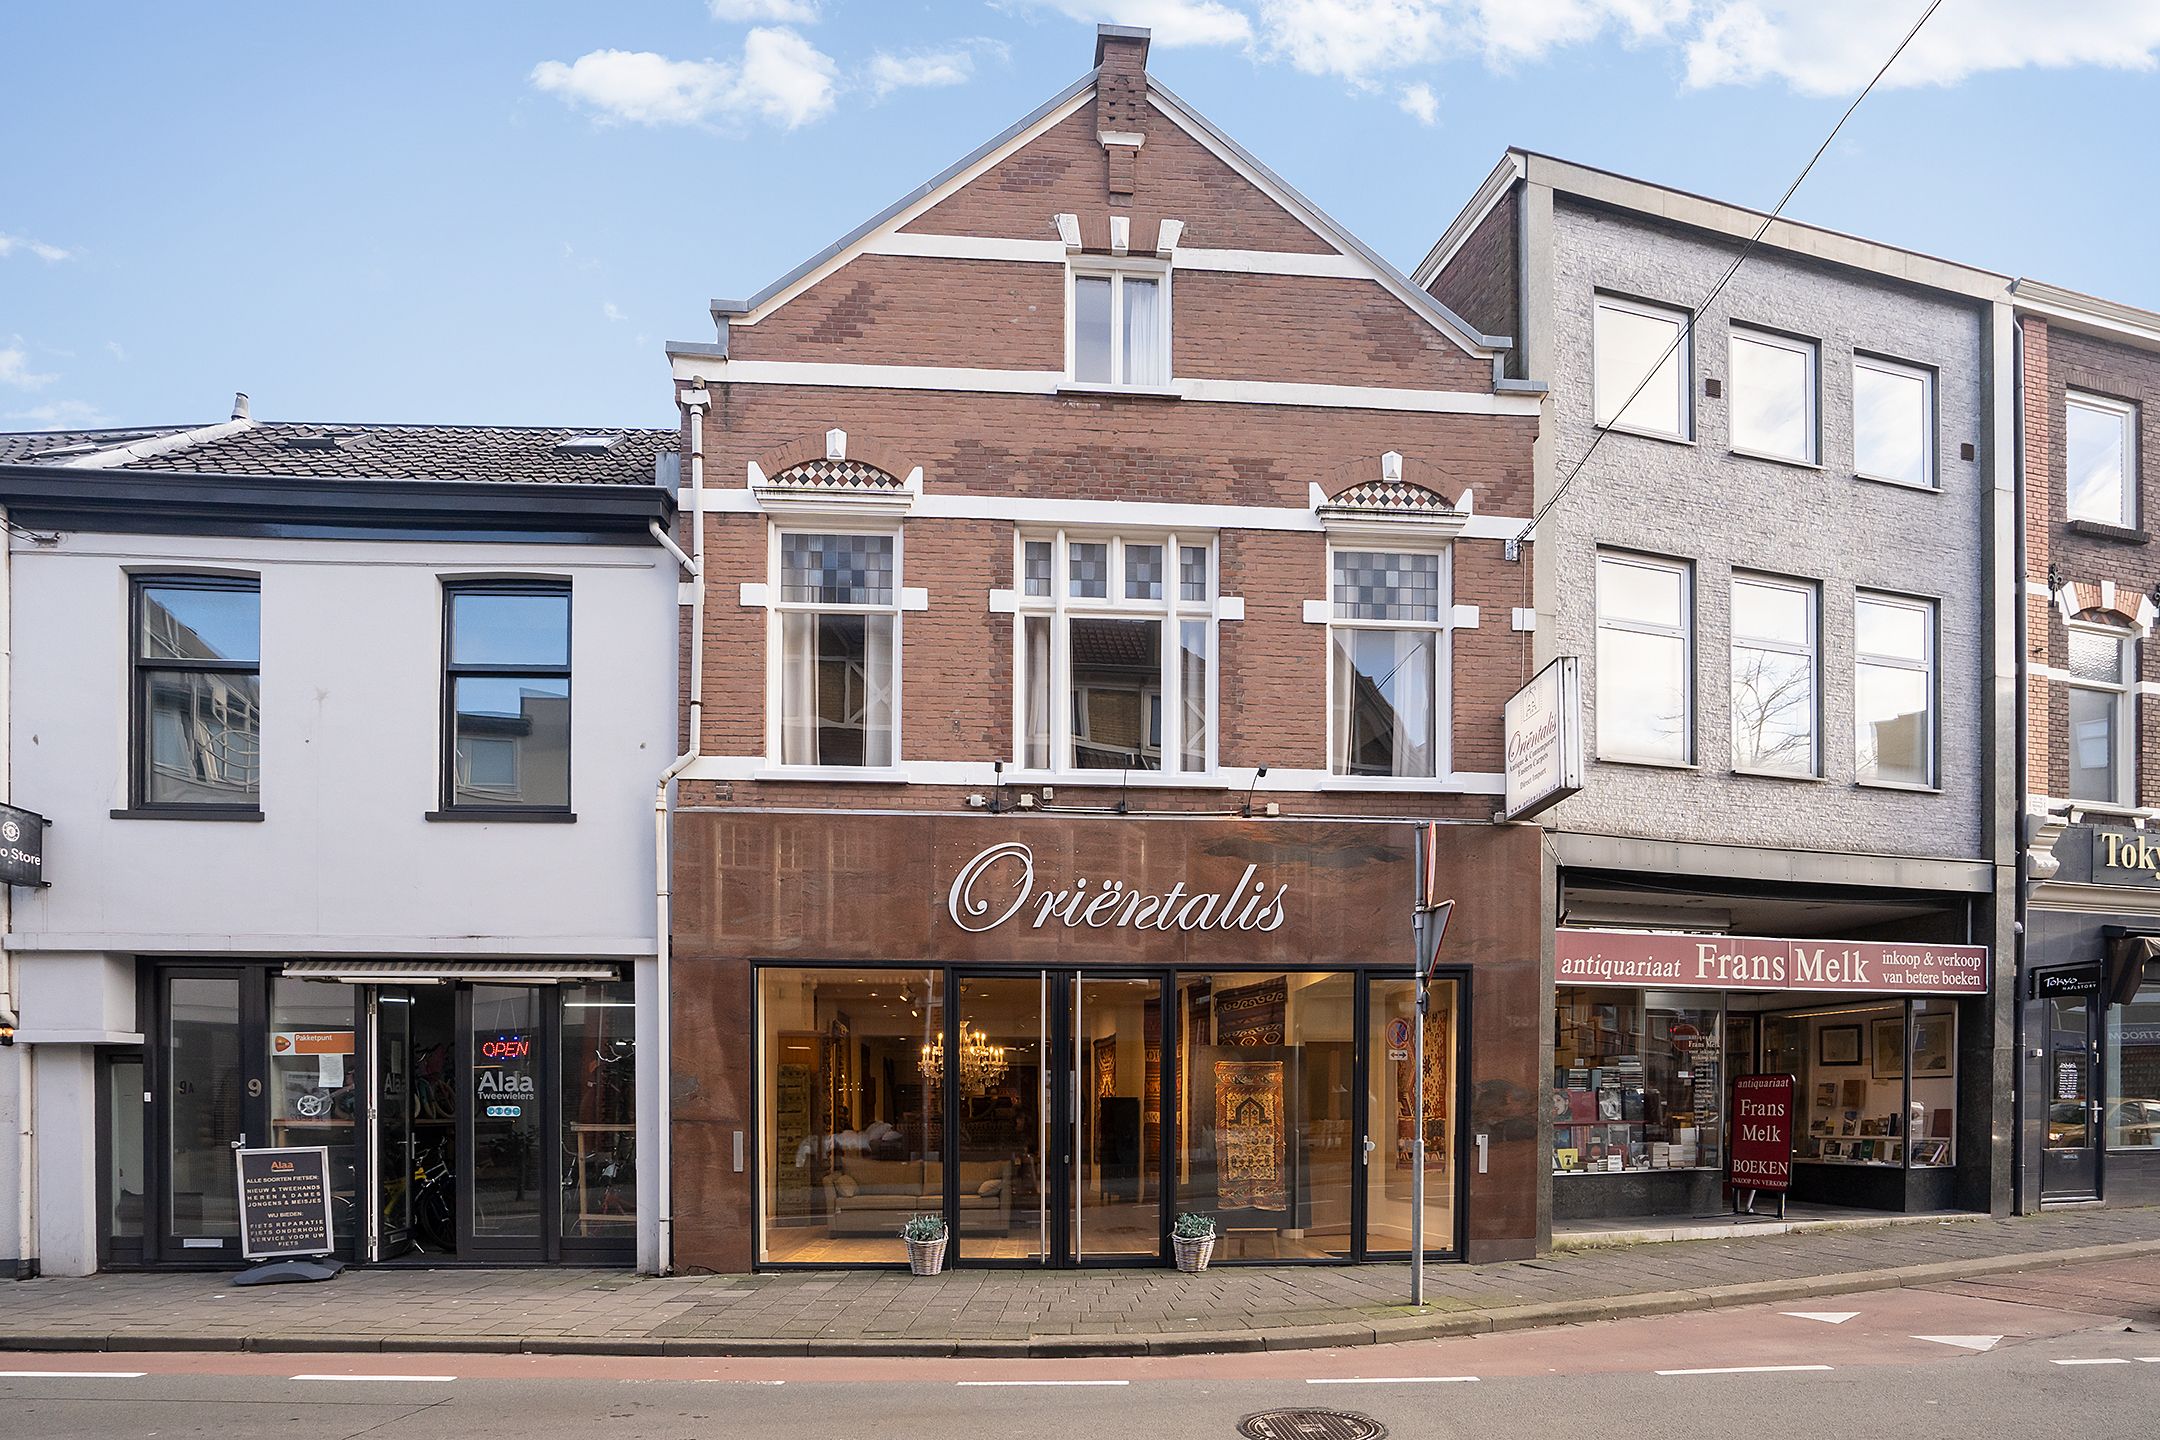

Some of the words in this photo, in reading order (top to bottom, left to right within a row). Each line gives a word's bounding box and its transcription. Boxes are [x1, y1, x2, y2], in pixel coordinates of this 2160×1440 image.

[1508, 711, 1556, 763] Oriëntalis
[1510, 759, 1525, 772] Antique
[1533, 753, 1549, 767] Carpets
[11, 847, 41, 866] Store
[948, 841, 1288, 933] Oriëntalis
[1561, 954, 1681, 980] antiquariaat
[1695, 943, 1786, 982] Frans
[1794, 948, 1870, 983] Melk
[1882, 950, 1920, 968] inkoop
[1923, 952, 1934, 966] &
[1937, 953, 1981, 971] verkoop
[1882, 973, 1903, 984] van
[1906, 970, 1939, 985] betere
[1942, 971, 1981, 986] boeken
[295, 1034, 333, 1043] Pakketpunt
[482, 1041, 529, 1057] OPEN
[248, 1078, 262, 1097] 9
[478, 1071, 535, 1092] Alaa
[1737, 1078, 1789, 1090] antiquariaat
[478, 1092, 535, 1100] Tweewielers
[1740, 1099, 1785, 1117] Frans
[1742, 1124, 1781, 1142] Melk
[271, 1161, 294, 1169] Alaa
[1733, 1159, 1789, 1175] BOEKEN
[1761, 1179, 1789, 1187] VERKOOP
[248, 1200, 282, 1208] JONGENS
[275, 1226, 324, 1235] ONDERHOUD
[276, 1219, 324, 1227] REPARATIE
